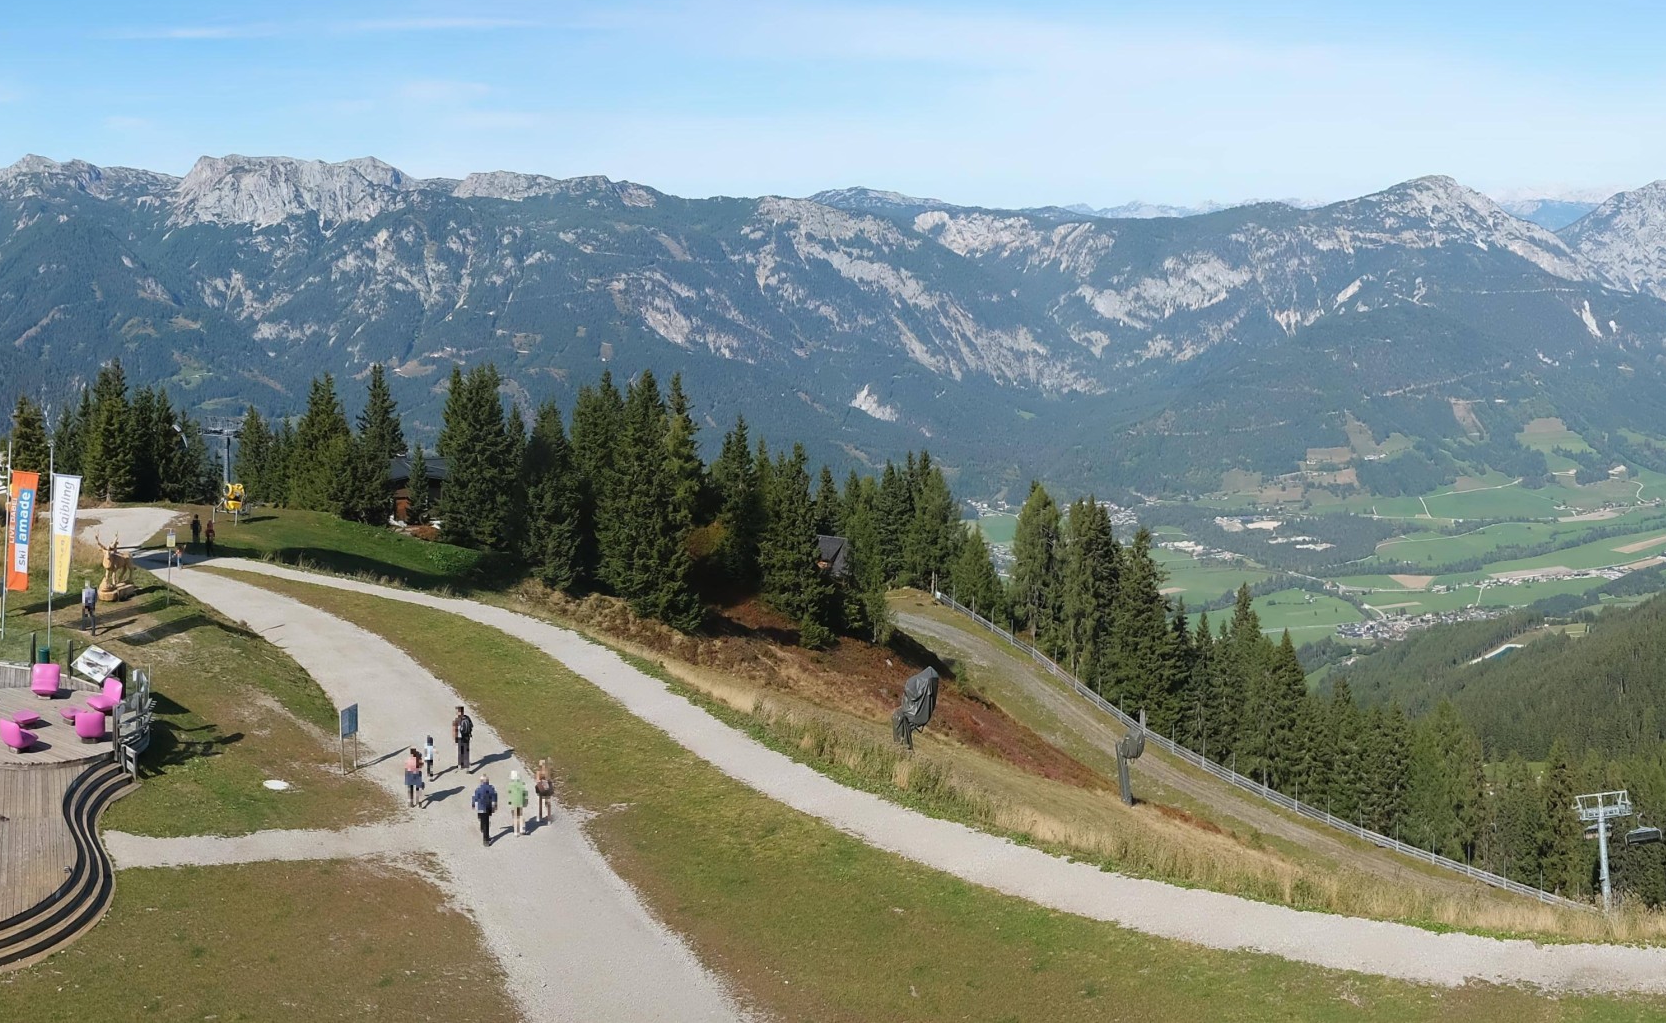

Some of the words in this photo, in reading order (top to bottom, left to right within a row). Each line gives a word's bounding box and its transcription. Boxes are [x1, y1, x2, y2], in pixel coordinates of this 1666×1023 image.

[18, 491, 31, 542] amade
[58, 481, 75, 532] Kaibling
[18, 550, 27, 566] Ski
